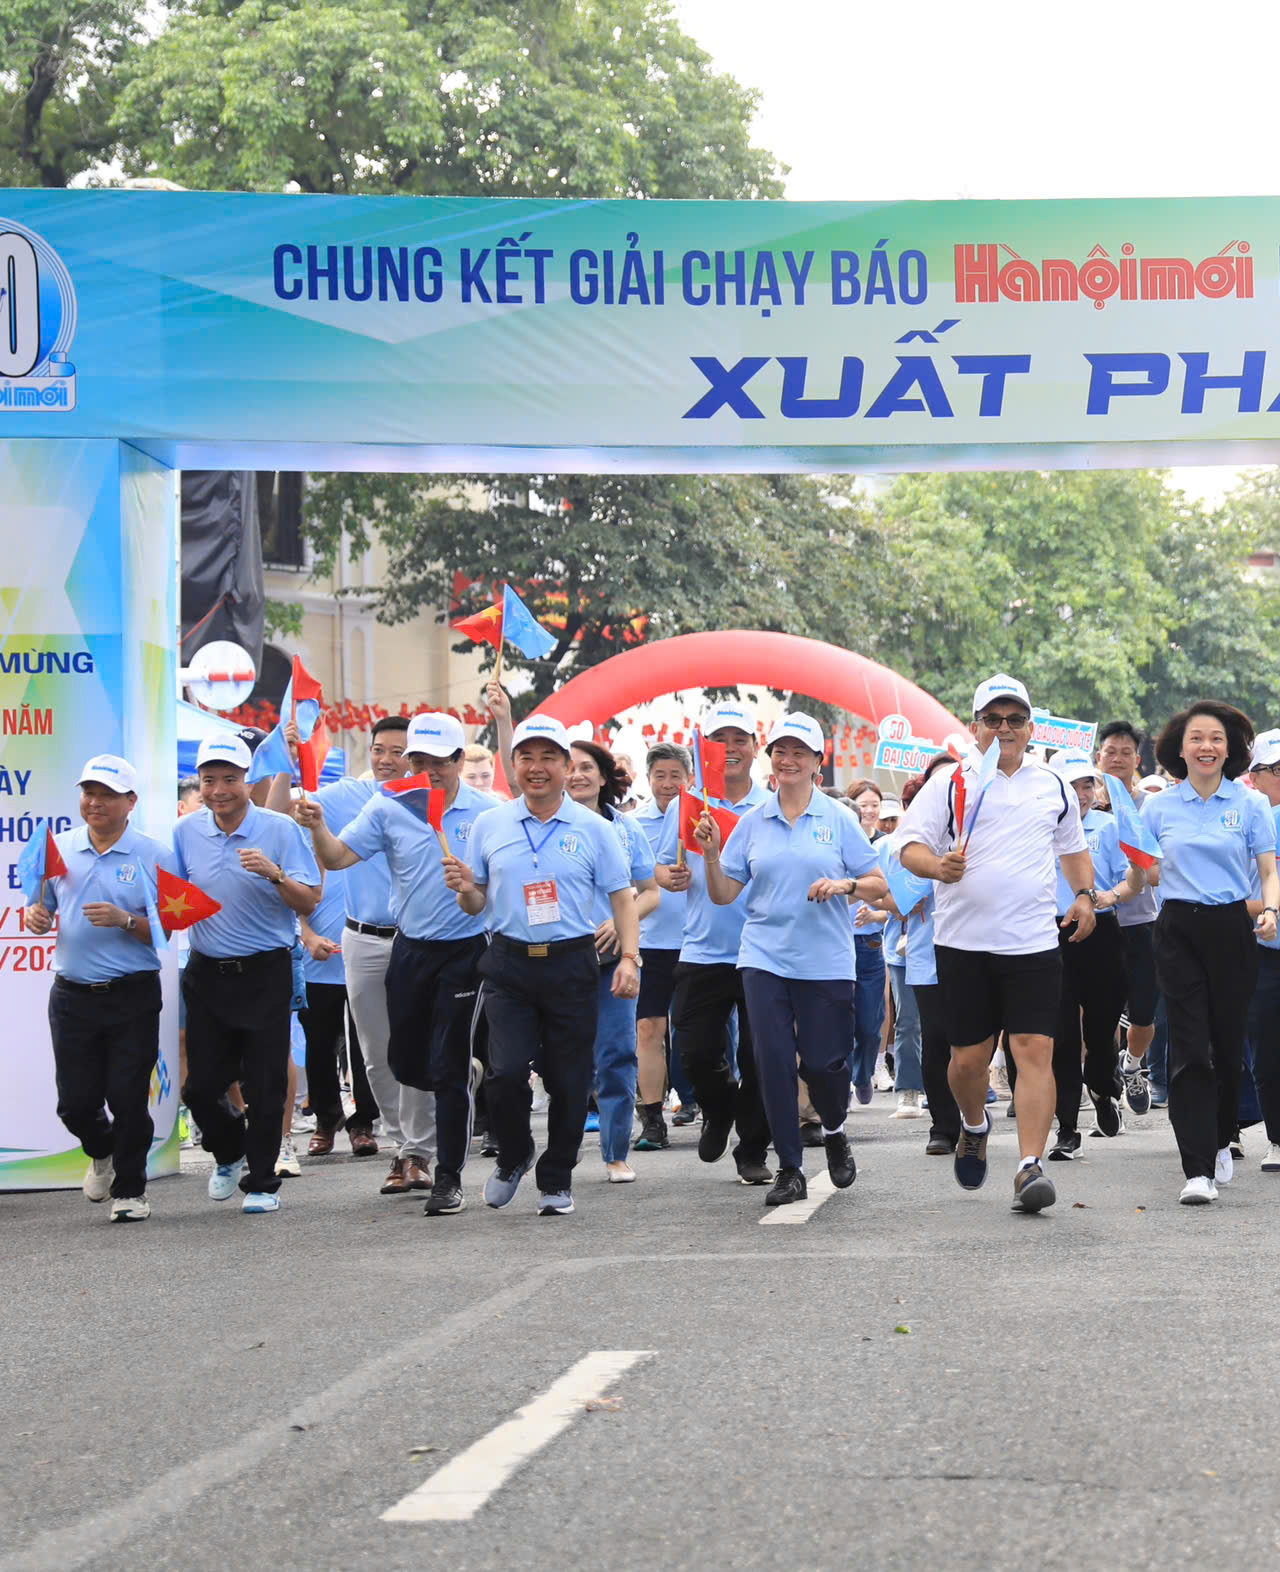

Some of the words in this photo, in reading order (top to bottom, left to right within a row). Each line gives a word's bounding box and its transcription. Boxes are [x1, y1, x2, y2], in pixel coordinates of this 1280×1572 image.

[272, 243, 443, 303] CHUNG
[459, 231, 554, 304] KẾT
[568, 231, 665, 306] GIẢI
[681, 249, 815, 318] CHẠY
[830, 238, 928, 306] BÁO
[953, 239, 1254, 311] Hànộimới
[681, 319, 1032, 419] XUẤT
[0, 648, 94, 675] MỪNG
[3, 703, 53, 735] NĂM
[889, 720, 905, 741] 50
[0, 811, 72, 842] HÓG
